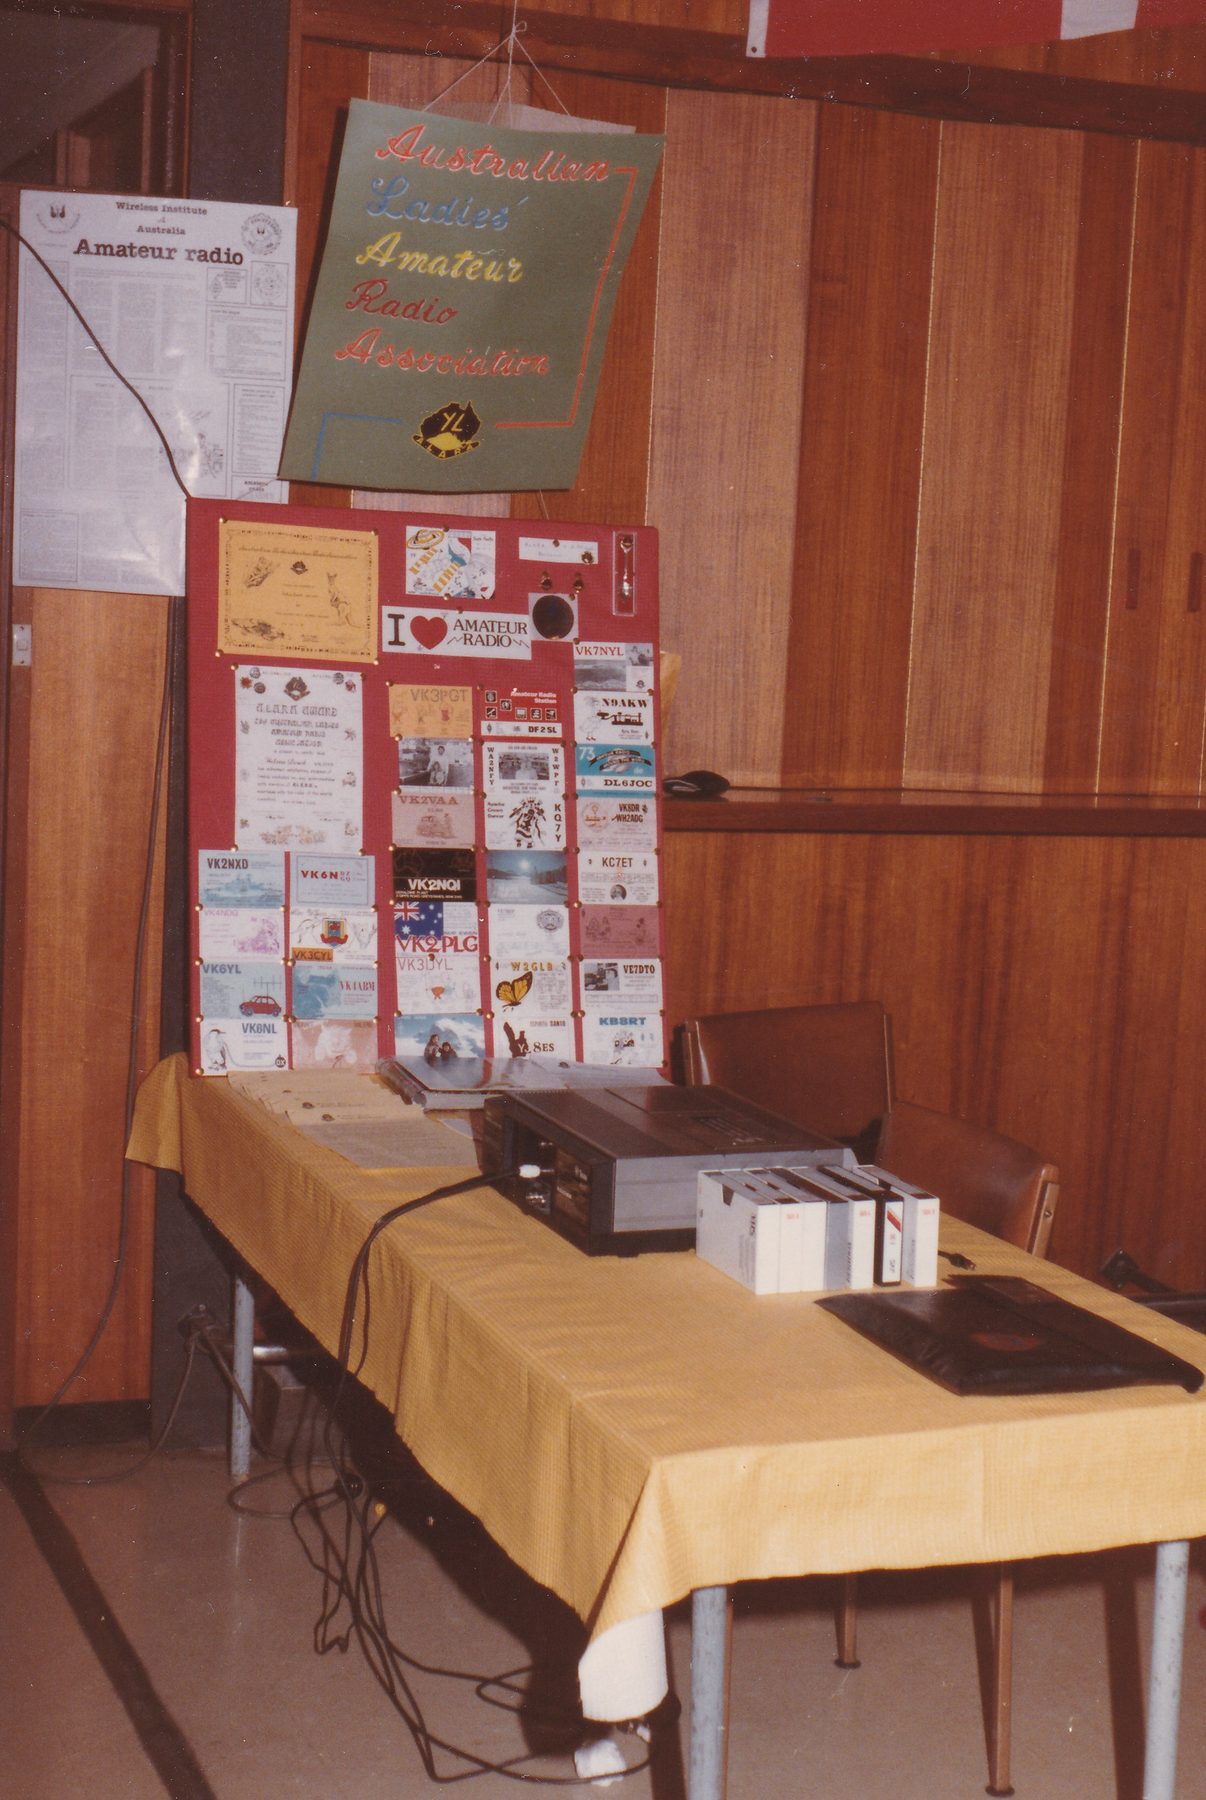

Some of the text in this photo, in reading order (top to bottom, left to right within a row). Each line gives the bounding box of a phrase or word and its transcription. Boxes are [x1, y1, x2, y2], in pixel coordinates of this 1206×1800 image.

[375, 123, 609, 183] Australian
[116, 201, 208, 215] Wireless Institute
[136, 225, 186, 235] Australia
[73, 238, 244, 265] Amateur radio
[356, 231, 524, 284] Amateur
[344, 278, 459, 325] Radio
[335, 327, 551, 376] Association
[440, 411, 465, 432] YL
[387, 613, 406, 647] I
[453, 619, 528, 635] AMATEUR
[463, 633, 512, 648] RADIO
[575, 645, 625, 657] VK7NYL
[409, 688, 469, 703] VK3PGT
[602, 698, 648, 709] N9AKW
[400, 795, 459, 806] VK2VAA
[207, 858, 249, 870] VK2NXD
[602, 857, 634, 868] KC7ET
[408, 878, 461, 892] VK2NQI
[394, 934, 479, 953] VK2PLG
[202, 963, 242, 975] VK6YL
